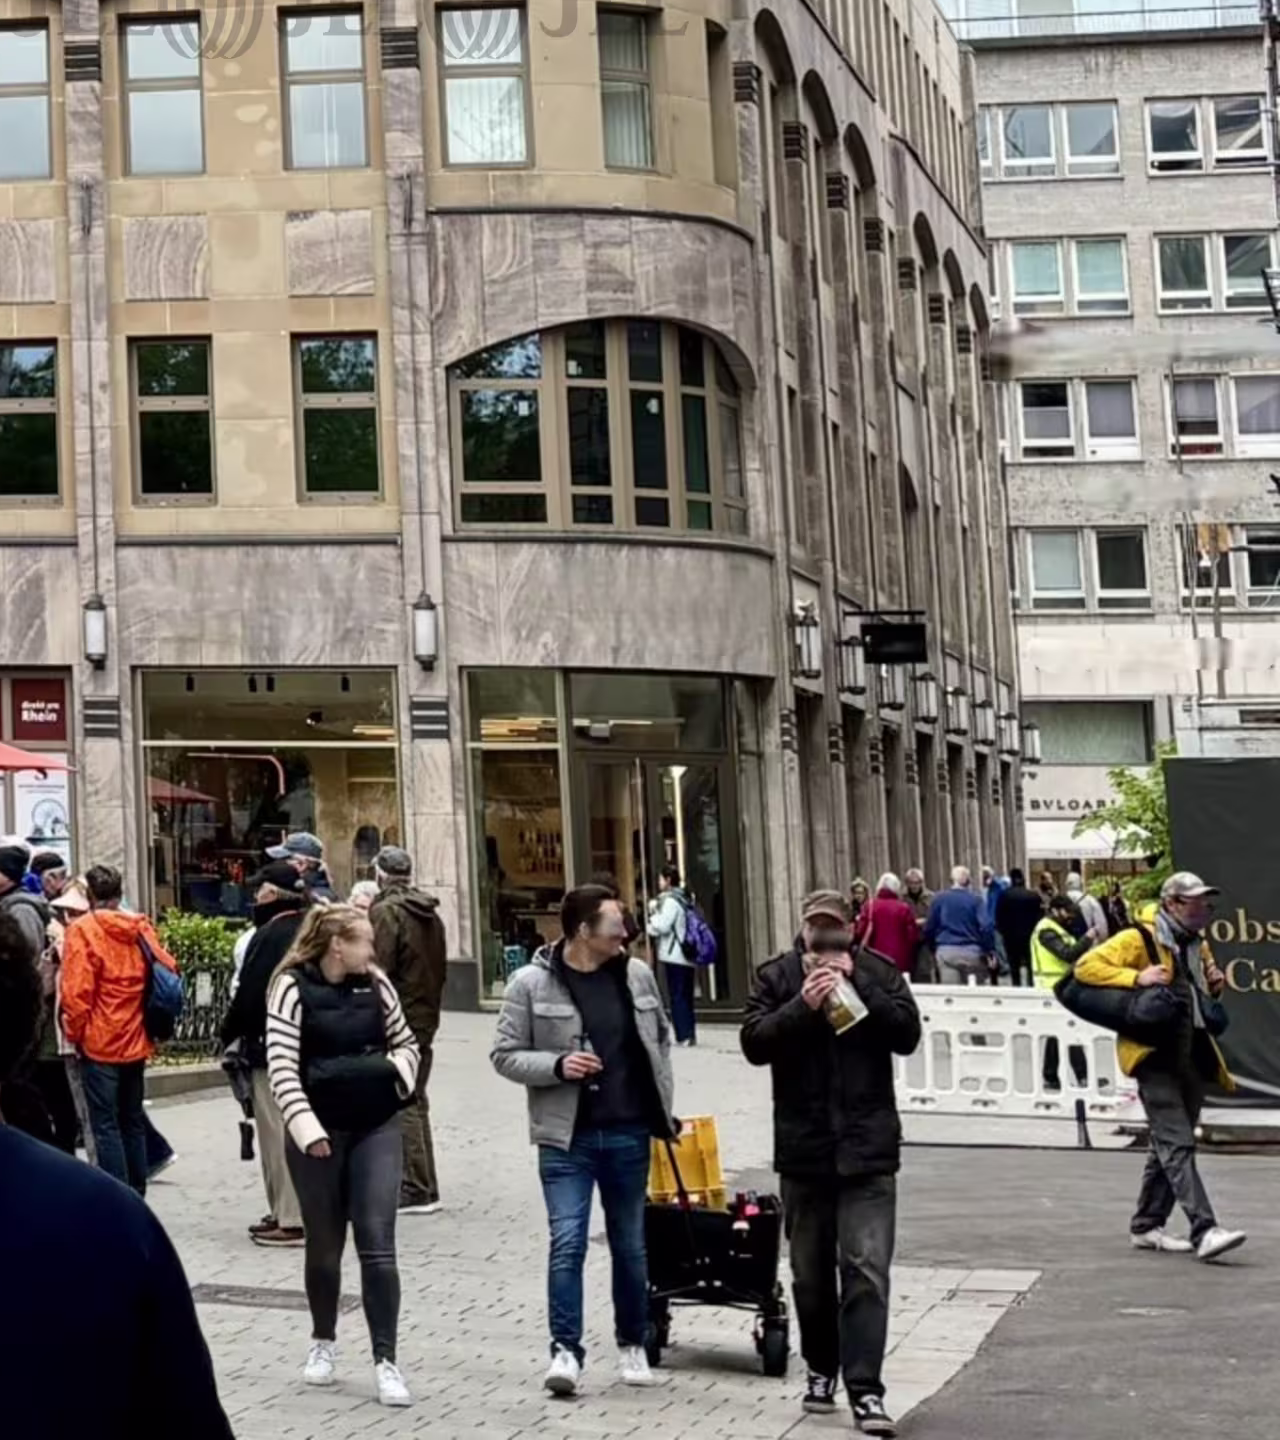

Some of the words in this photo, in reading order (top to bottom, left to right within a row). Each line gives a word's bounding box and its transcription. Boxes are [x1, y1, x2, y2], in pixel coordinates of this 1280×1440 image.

[21, 710, 58, 722] Rhein
[1198, 907, 1280, 943] obs
[1225, 958, 1280, 992] Ca
